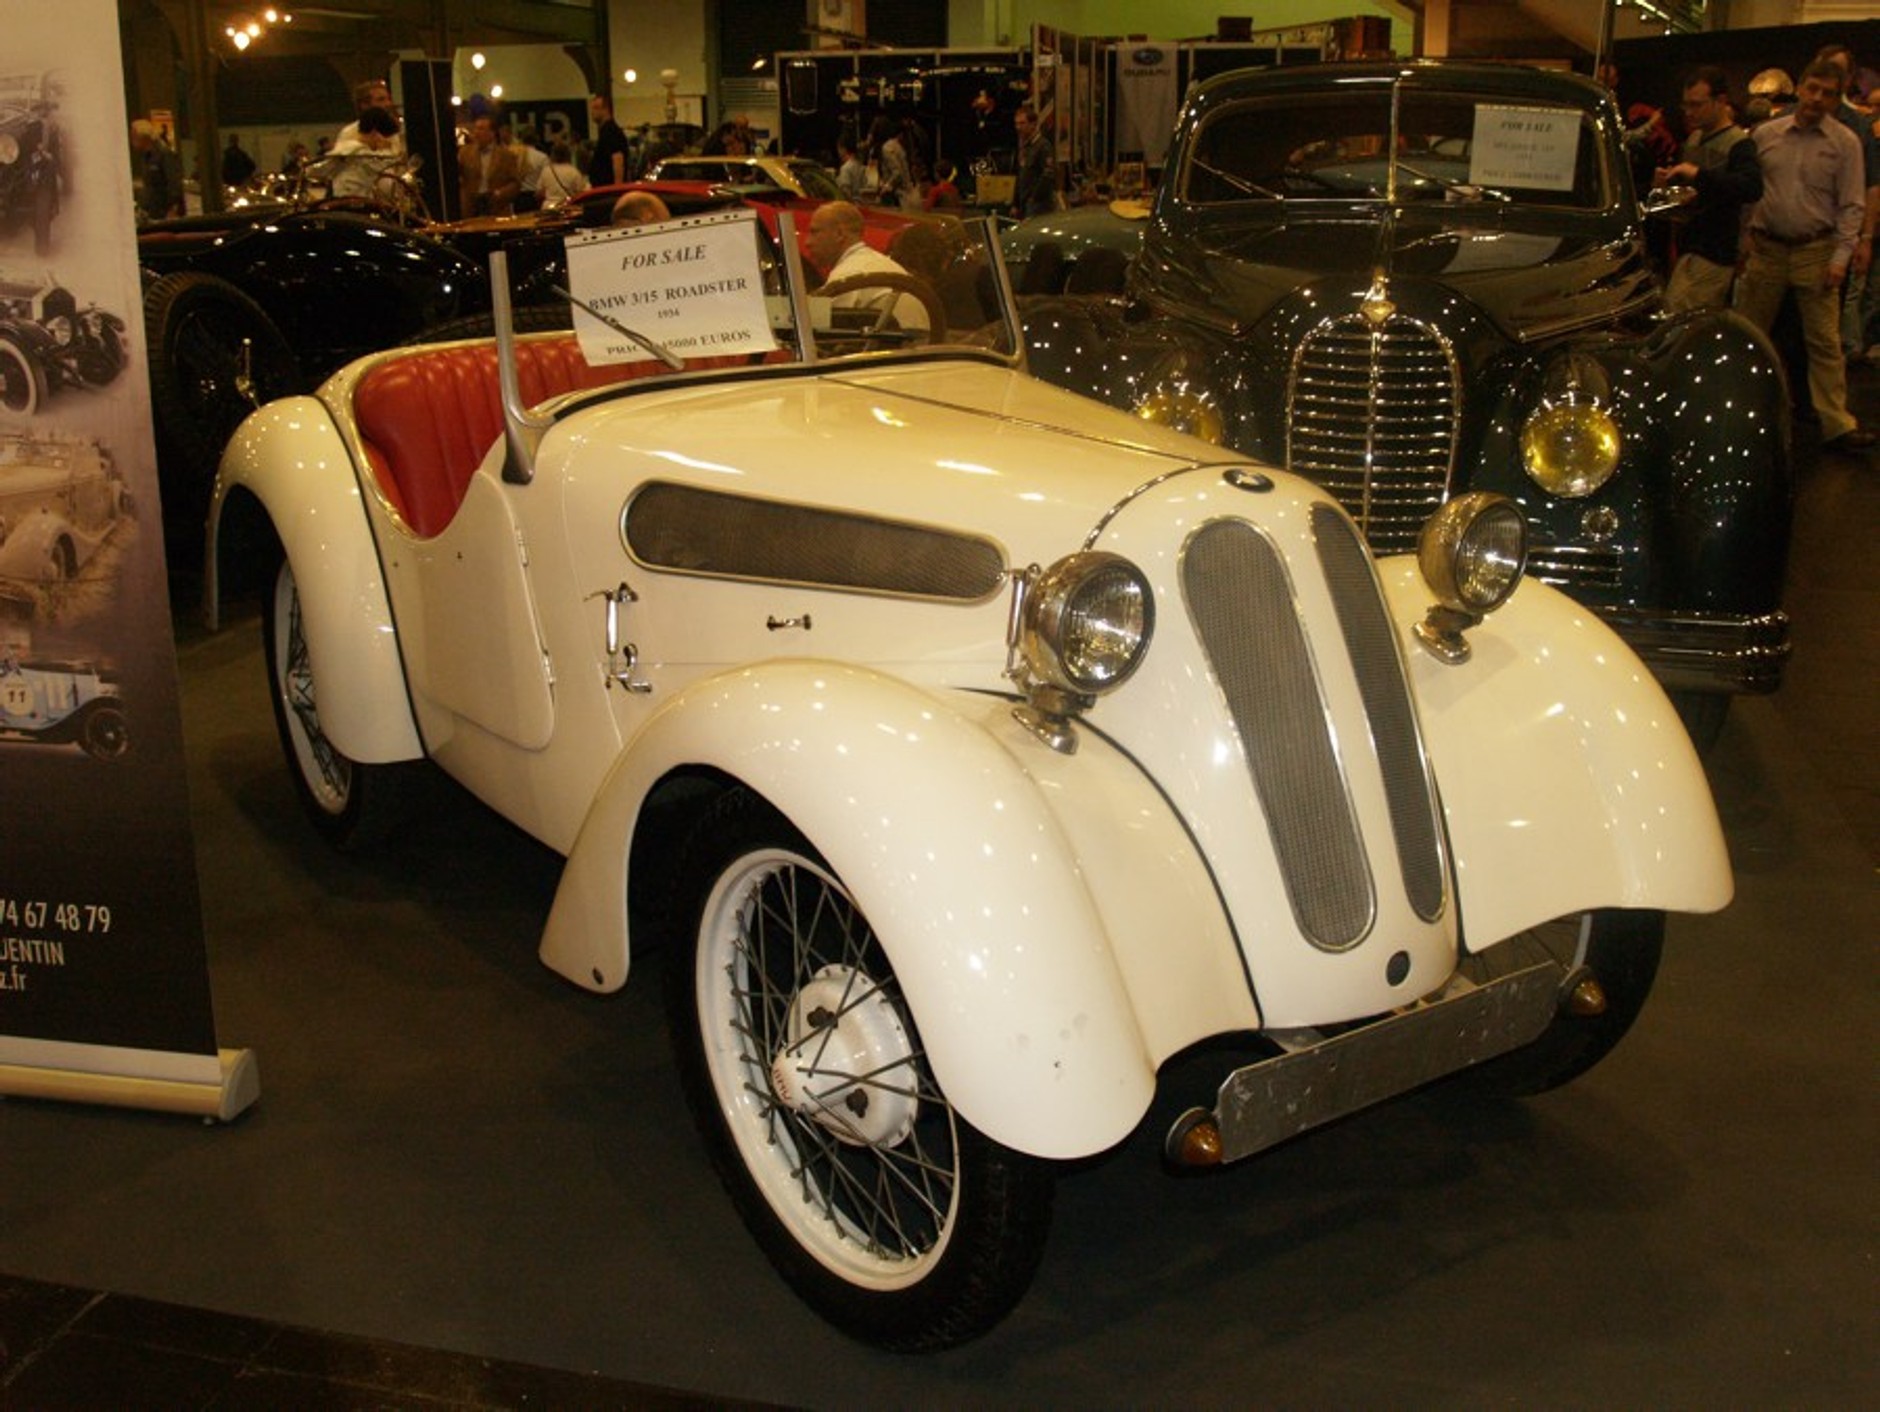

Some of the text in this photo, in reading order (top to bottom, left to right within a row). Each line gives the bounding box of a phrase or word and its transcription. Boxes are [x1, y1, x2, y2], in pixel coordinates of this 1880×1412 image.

[621, 245, 707, 271] FOR SALE
[589, 278, 748, 310] BMW 3/15 ROADSTER
[701, 330, 751, 346] EUROS
[9, 690, 25, 703] 11
[24, 901, 48, 928] 67
[54, 903, 81, 931] 48
[84, 904, 111, 932] 79
